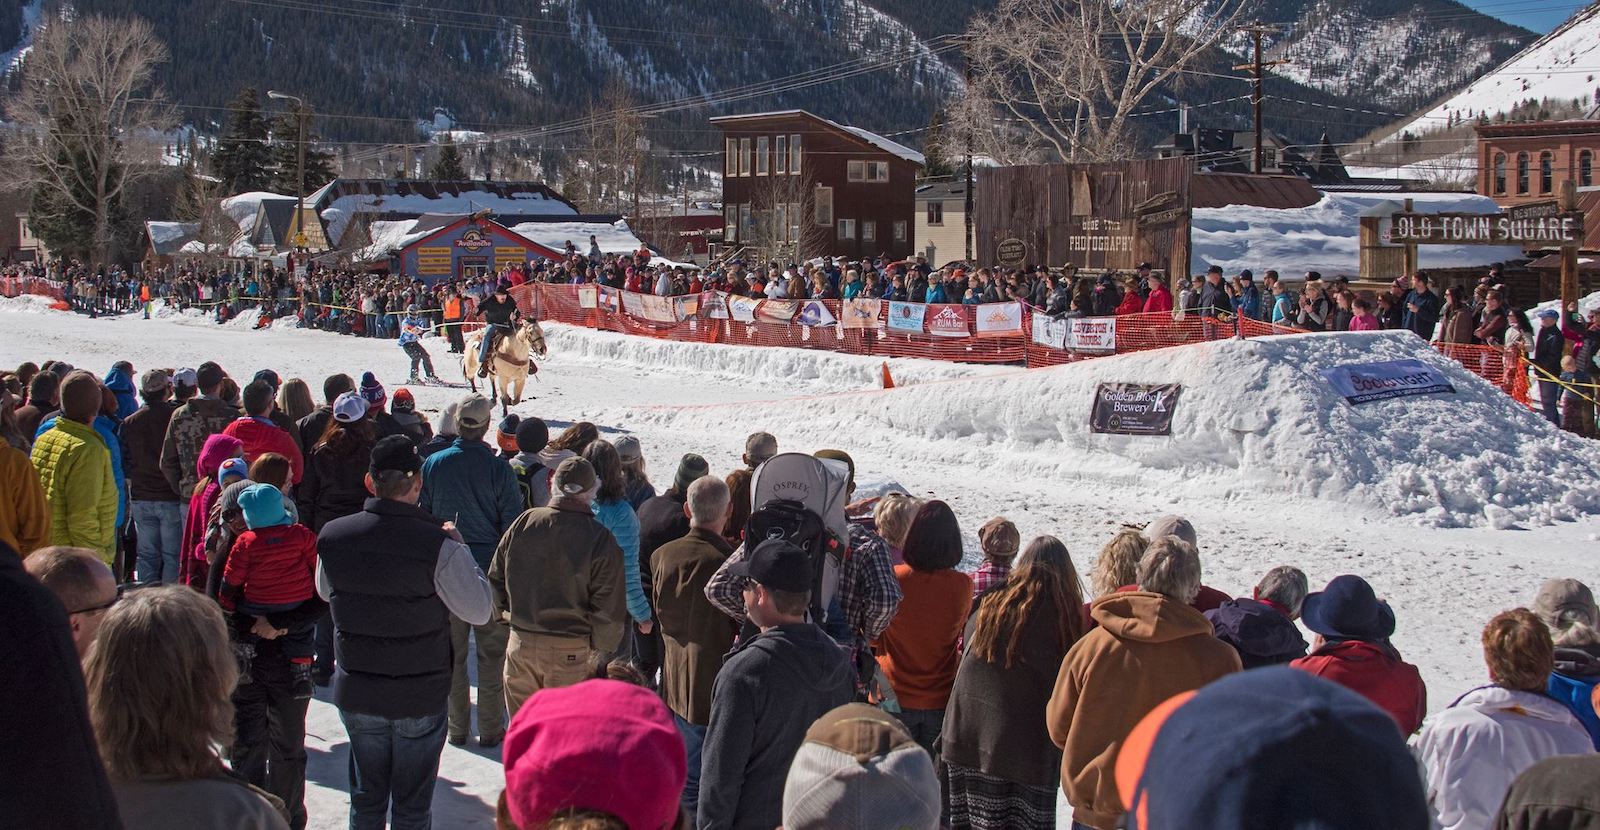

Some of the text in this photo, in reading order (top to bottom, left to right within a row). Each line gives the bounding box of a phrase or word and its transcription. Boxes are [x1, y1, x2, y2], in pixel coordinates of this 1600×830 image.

[1399, 217, 1574, 241] OLD TOWN SQUARE
[1069, 235, 1134, 251] PHOTOGRAPHY
[1397, 371, 1434, 387] LIGHT
[1104, 390, 1134, 401] Golden
[1113, 401, 1150, 415] Brewery
[773, 481, 811, 493] OSPREY
